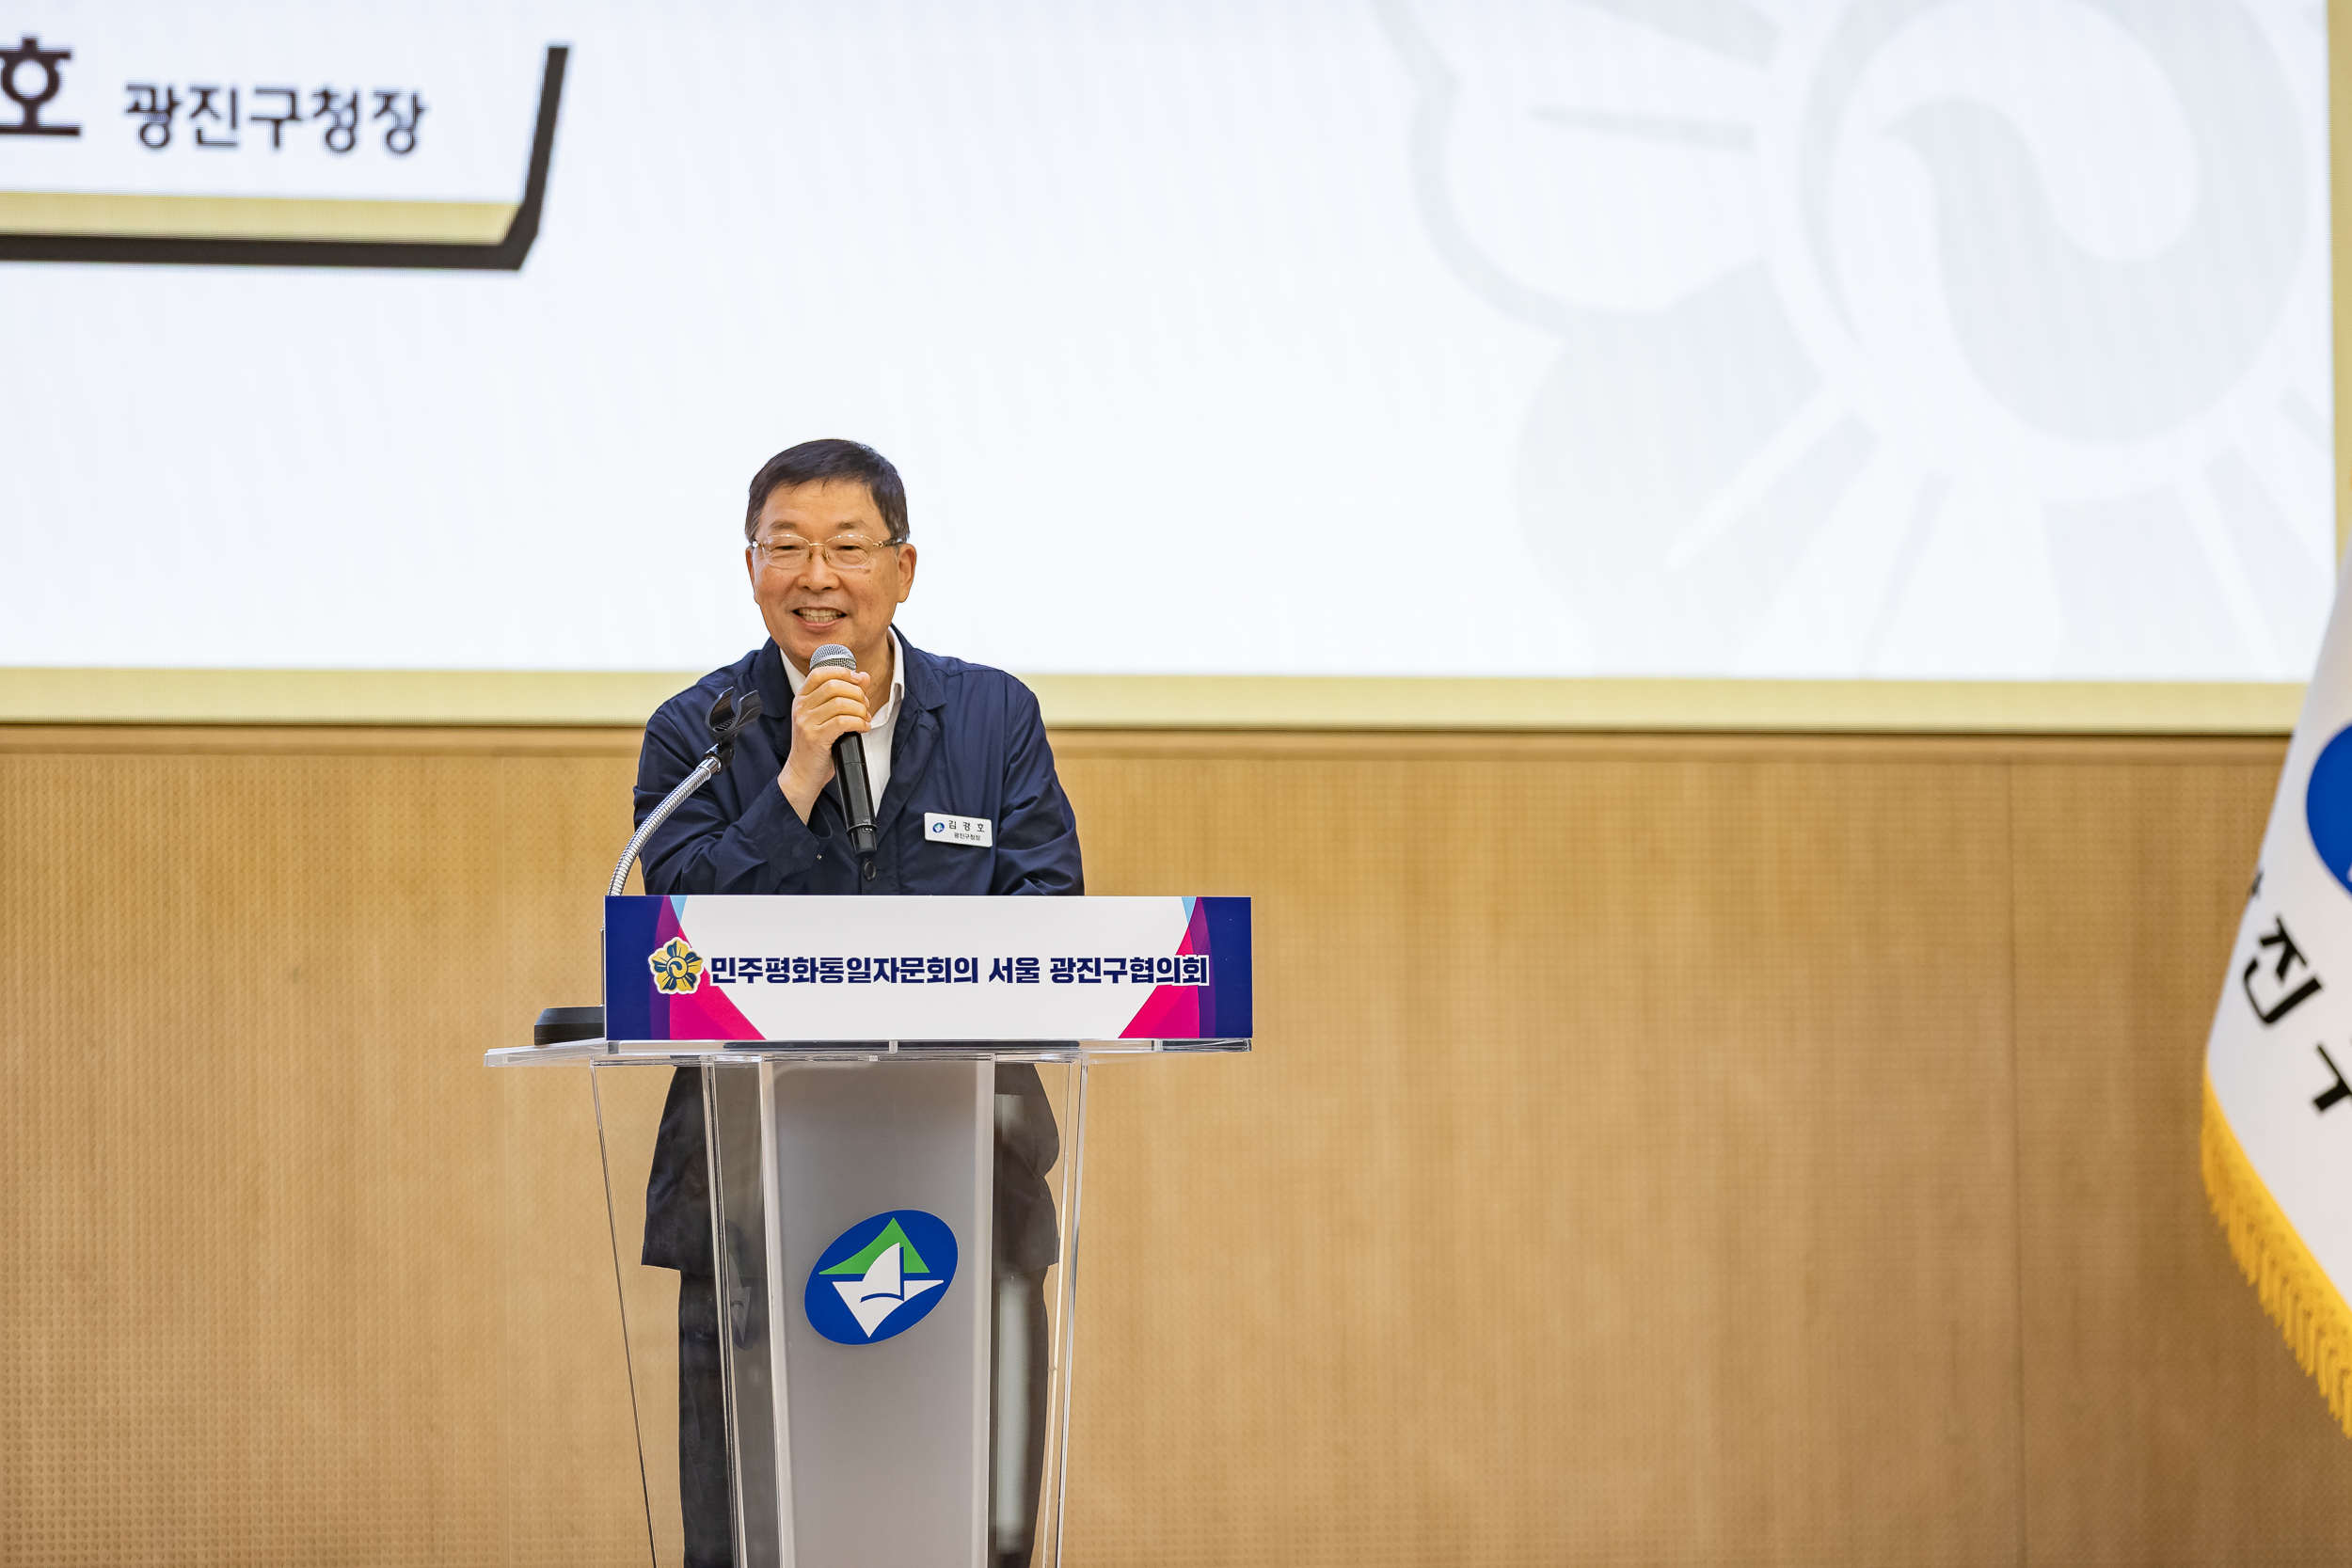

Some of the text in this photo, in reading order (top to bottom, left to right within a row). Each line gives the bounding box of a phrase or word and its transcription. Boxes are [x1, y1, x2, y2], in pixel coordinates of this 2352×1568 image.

[0, 36, 427, 155] 호 광진구청장
[711, 957, 1208, 984] 민주평화통일자문회의 서울 광진구협의회
